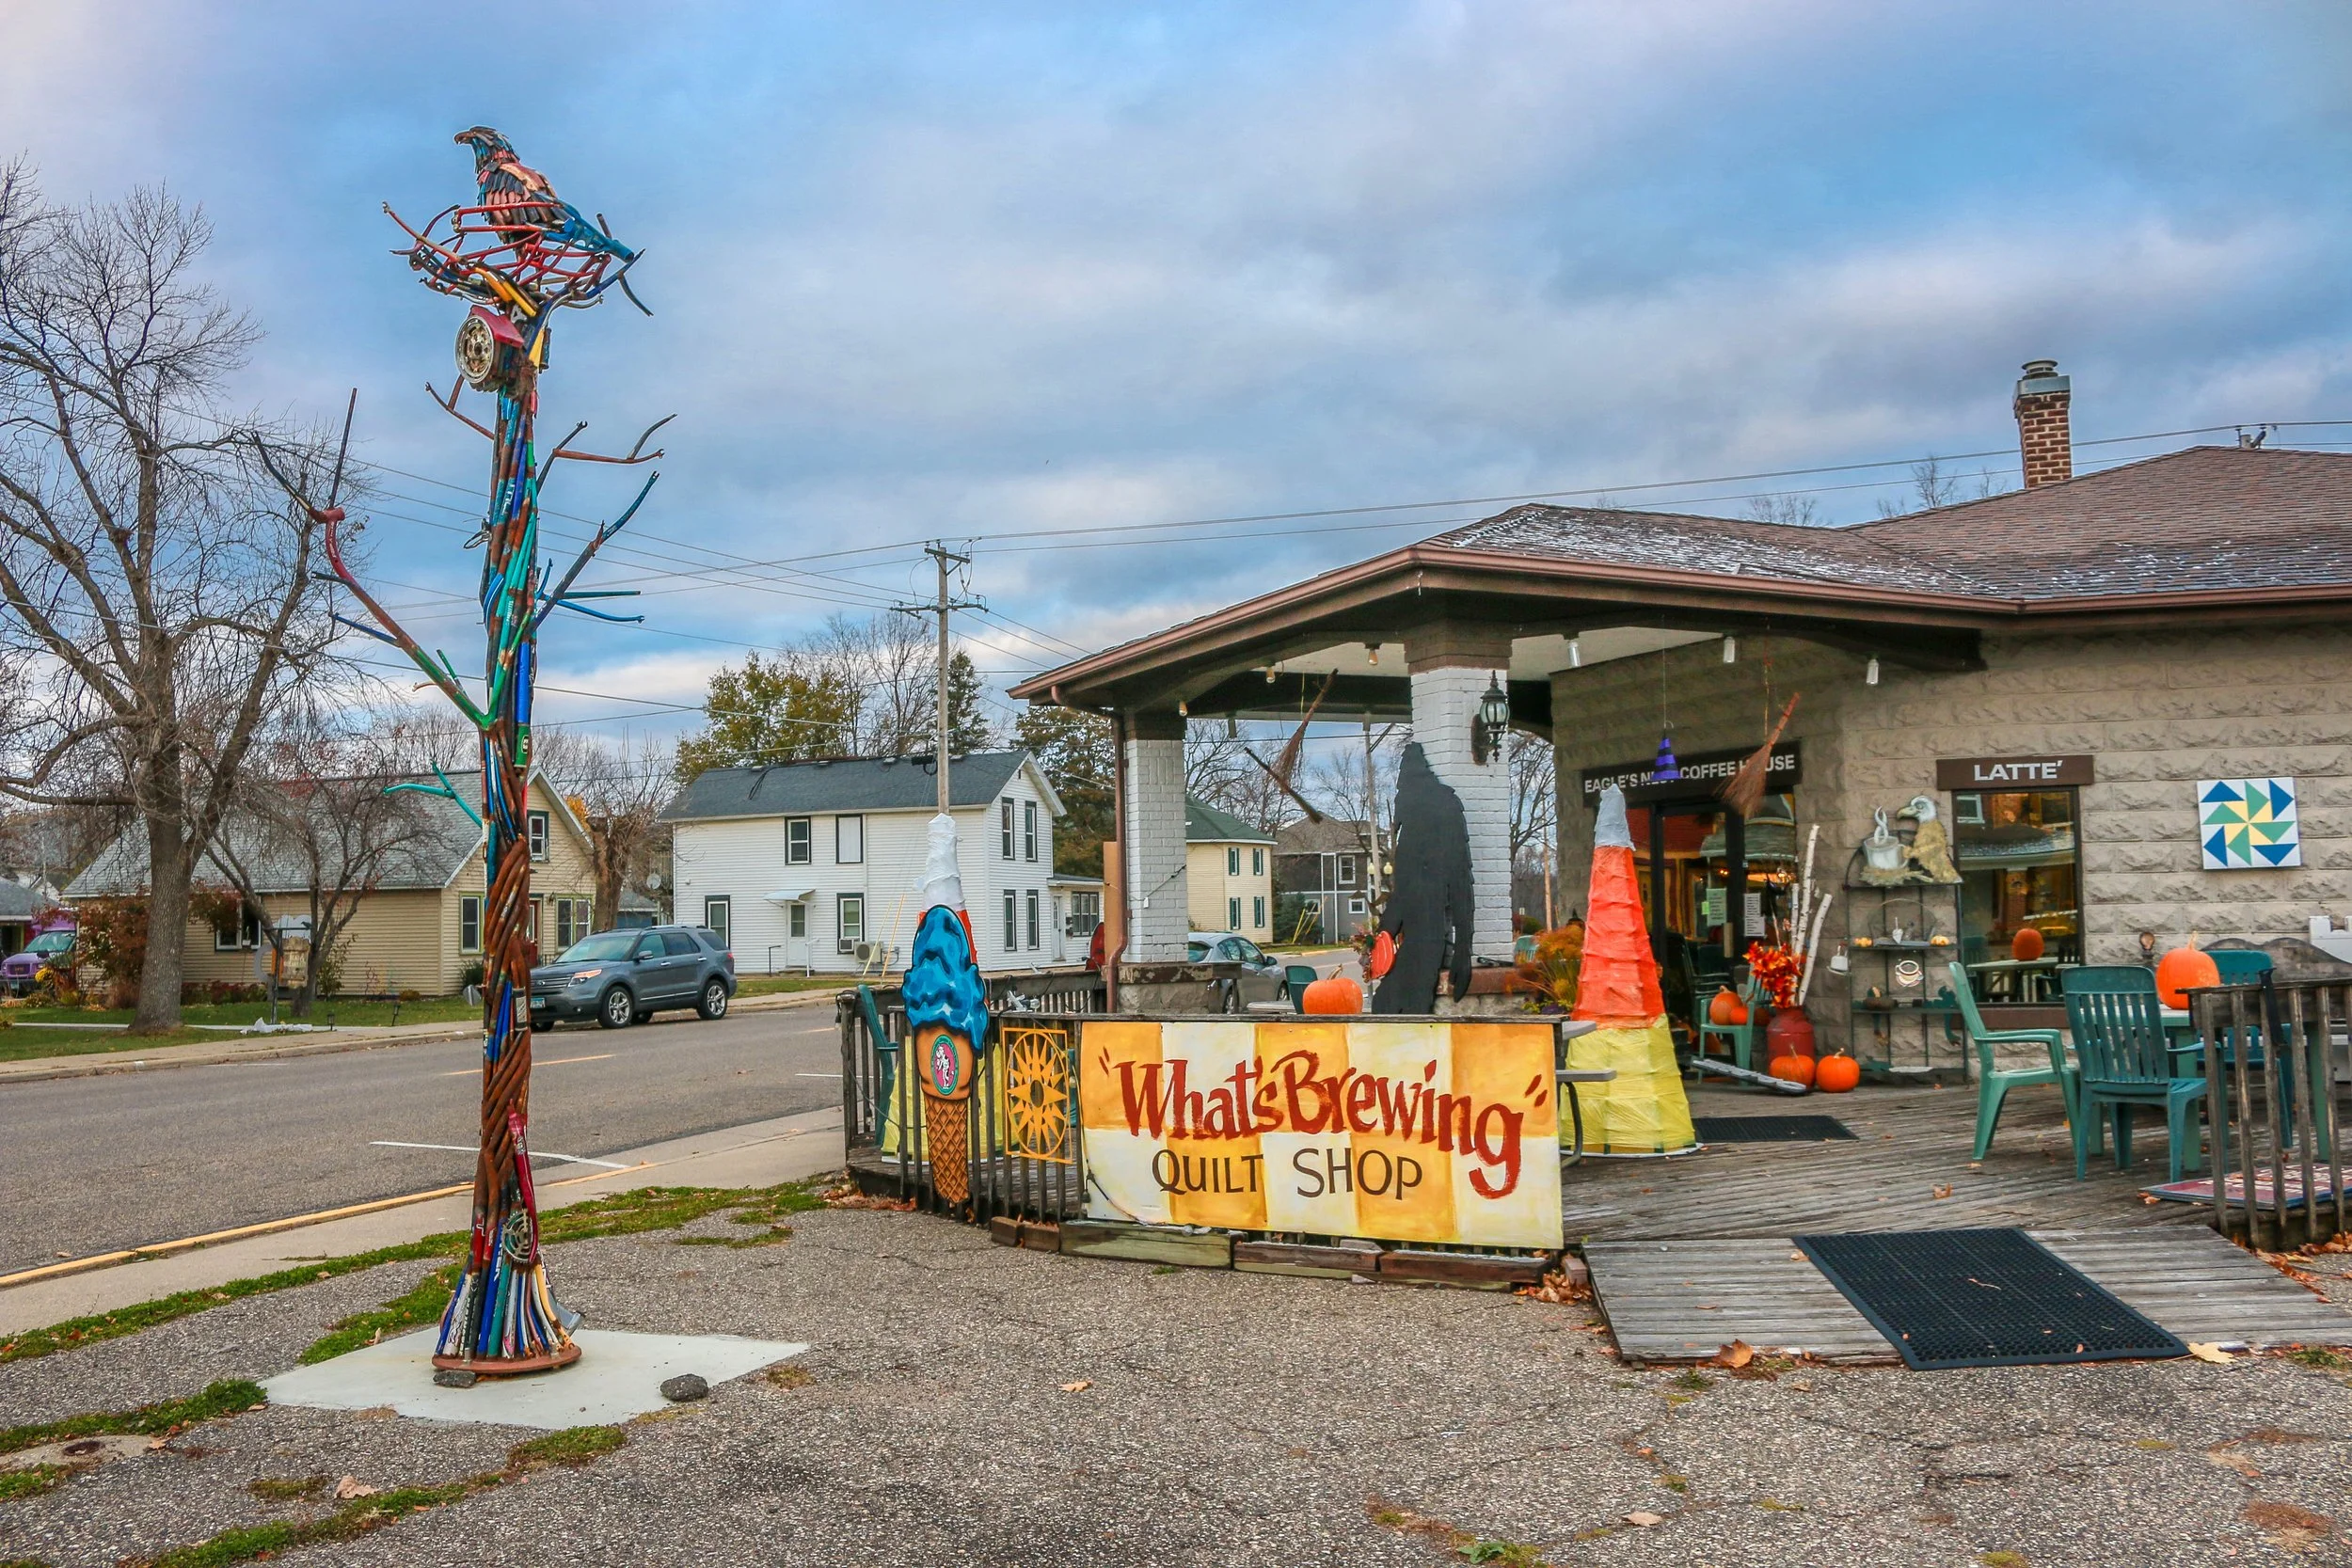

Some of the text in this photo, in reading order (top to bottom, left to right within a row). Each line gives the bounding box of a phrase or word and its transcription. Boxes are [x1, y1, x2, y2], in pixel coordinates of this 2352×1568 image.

[1679, 760, 1736, 780] COFFEE
[1739, 754, 1795, 773] HUSE
[1152, 1147, 1423, 1201] QUILT SHOP
